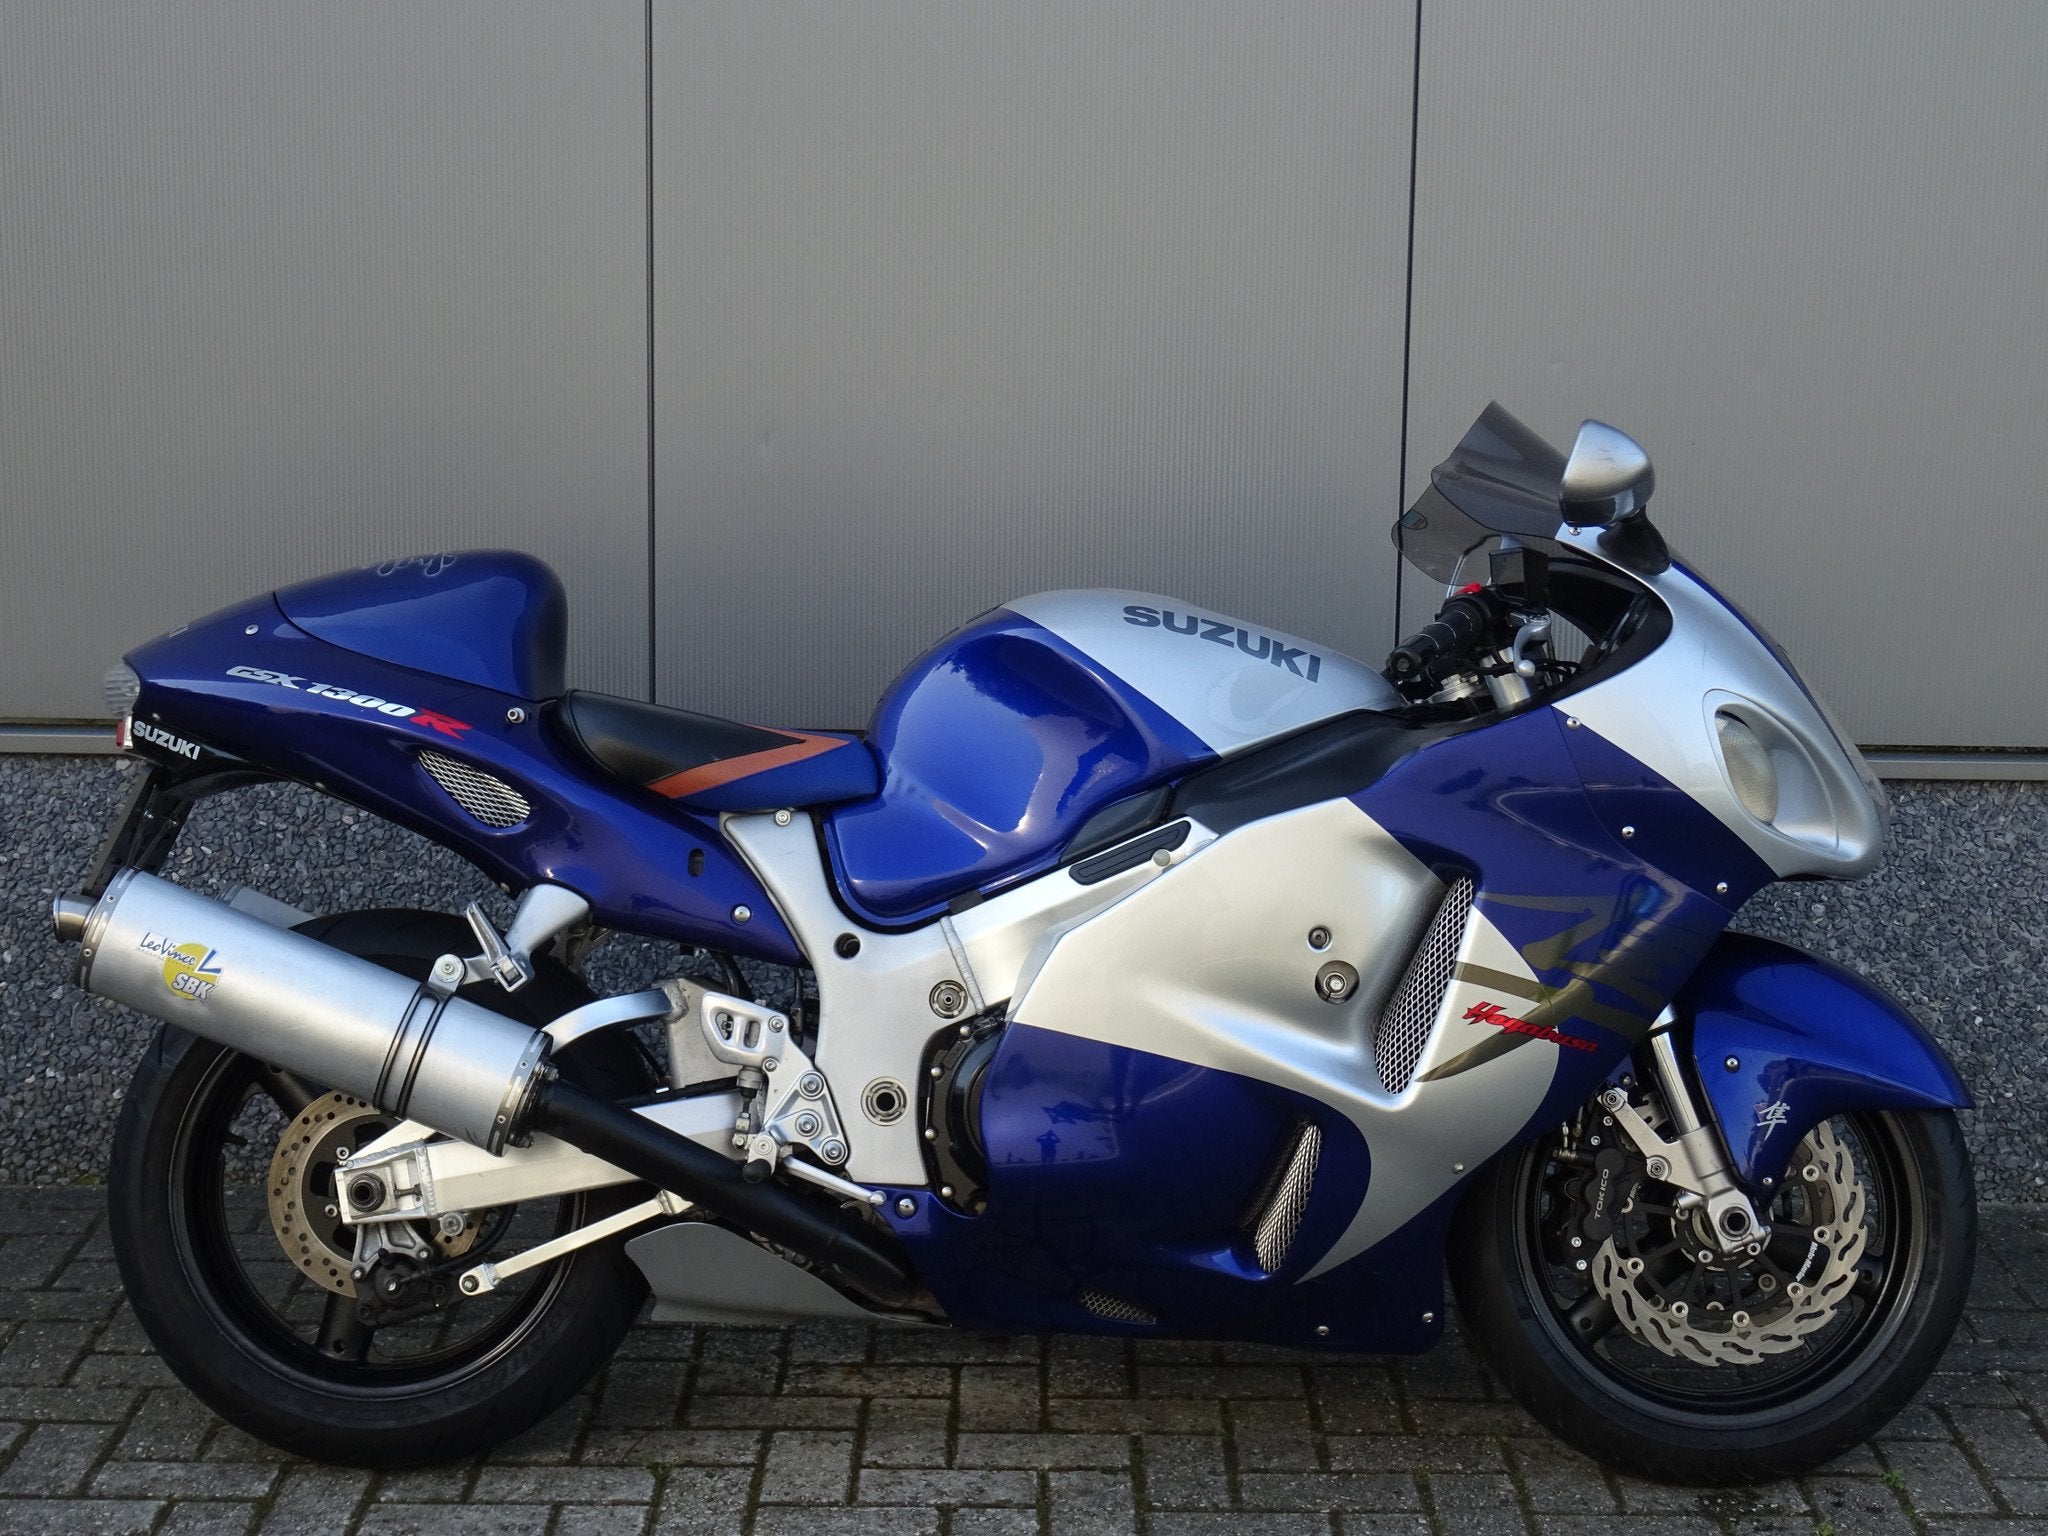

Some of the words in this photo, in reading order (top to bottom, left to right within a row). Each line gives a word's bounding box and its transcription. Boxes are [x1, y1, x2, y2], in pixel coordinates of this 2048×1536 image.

[1122, 604, 1321, 684] SUZUKI
[226, 665, 307, 690] GSX
[133, 720, 201, 761] SUZUKI
[140, 931, 196, 966] LeoVince
[171, 972, 217, 1001] SBK
[1462, 1000, 1599, 1053] Hayabusa
[1594, 1168, 1610, 1220] TOKICO
